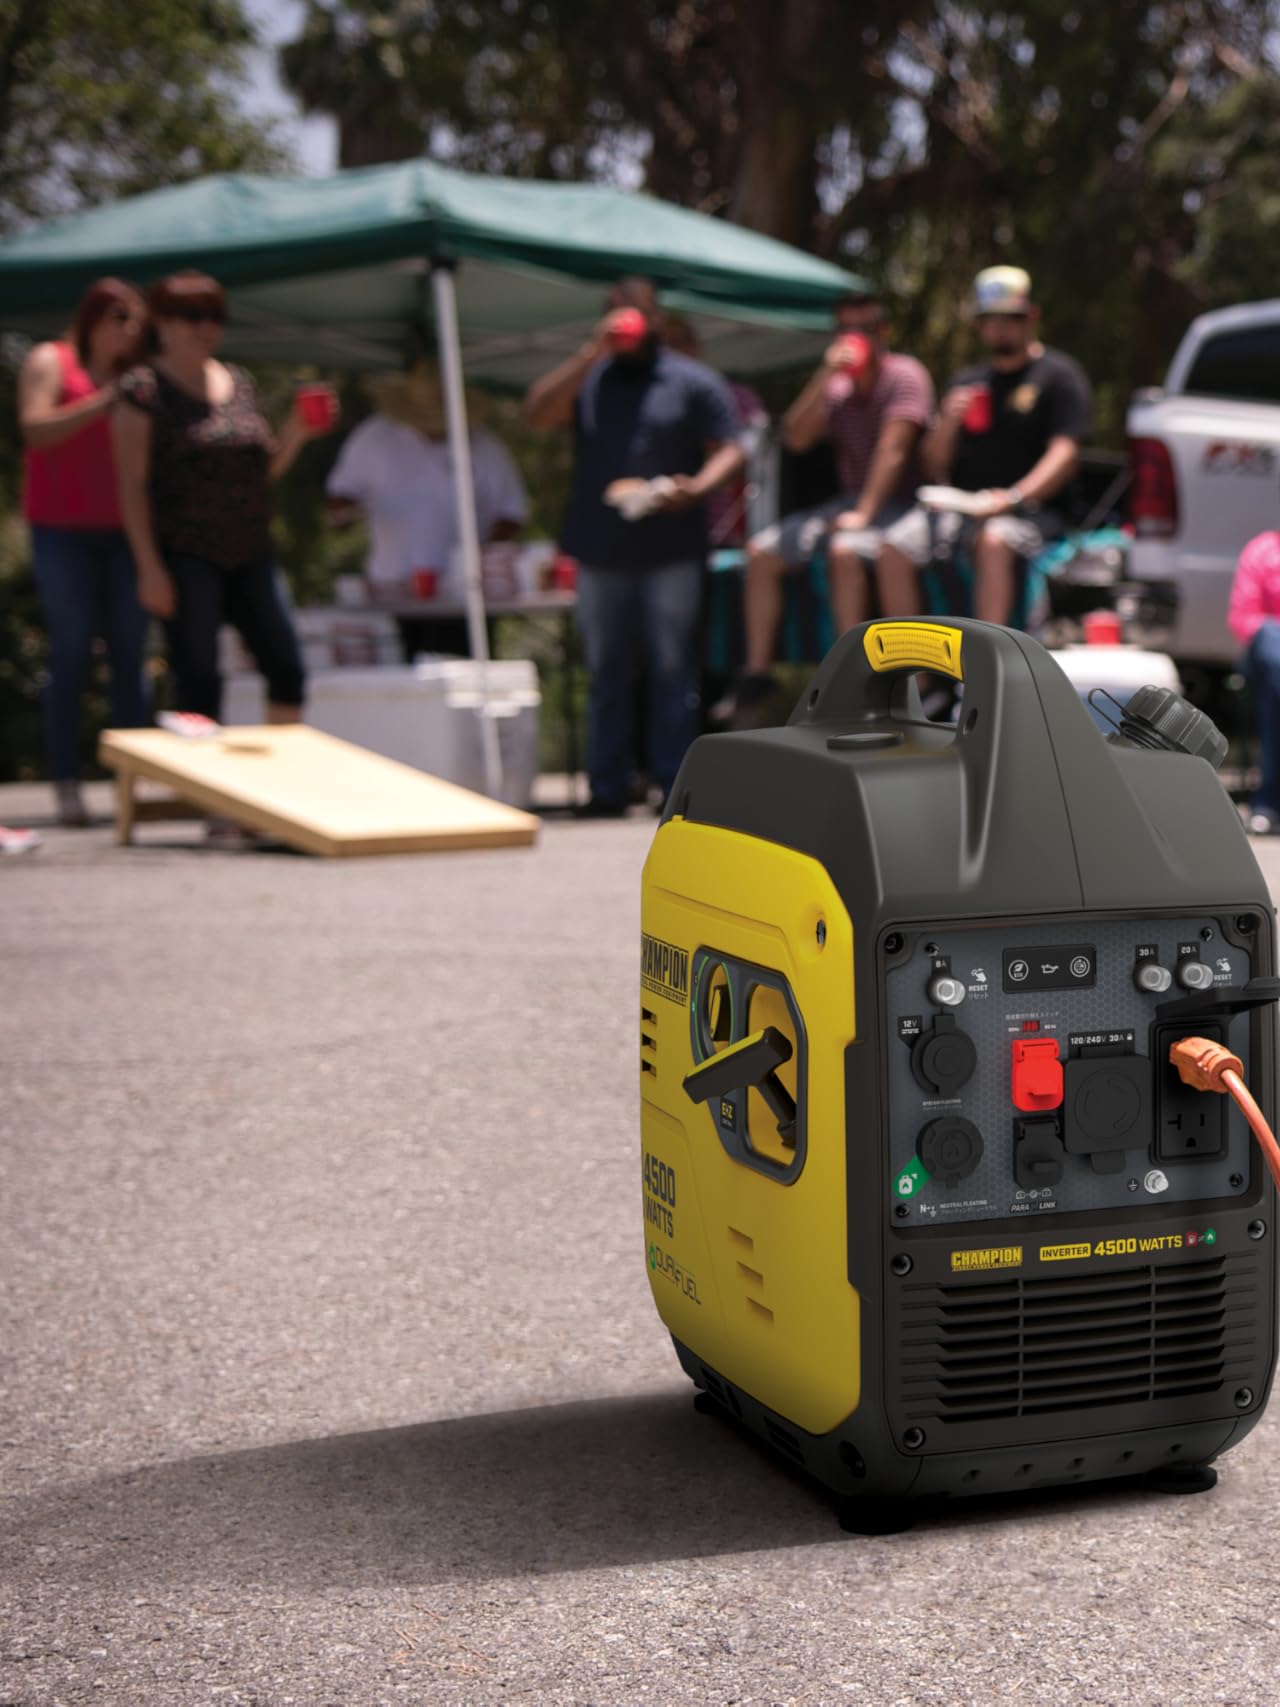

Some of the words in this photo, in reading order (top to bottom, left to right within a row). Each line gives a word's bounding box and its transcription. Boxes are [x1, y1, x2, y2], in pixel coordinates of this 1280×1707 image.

[968, 984, 988, 992] RESET
[903, 1020, 917, 1028] 12V
[644, 1152, 675, 1208] 4500
[1011, 1203, 1030, 1212] PARA
[1039, 1201, 1057, 1209] LINK
[1042, 1246, 1089, 1258] INVERTER
[1094, 1238, 1137, 1256] 4500
[1139, 1235, 1183, 1252] WATTS
[952, 1247, 1022, 1266] CHAMPION
